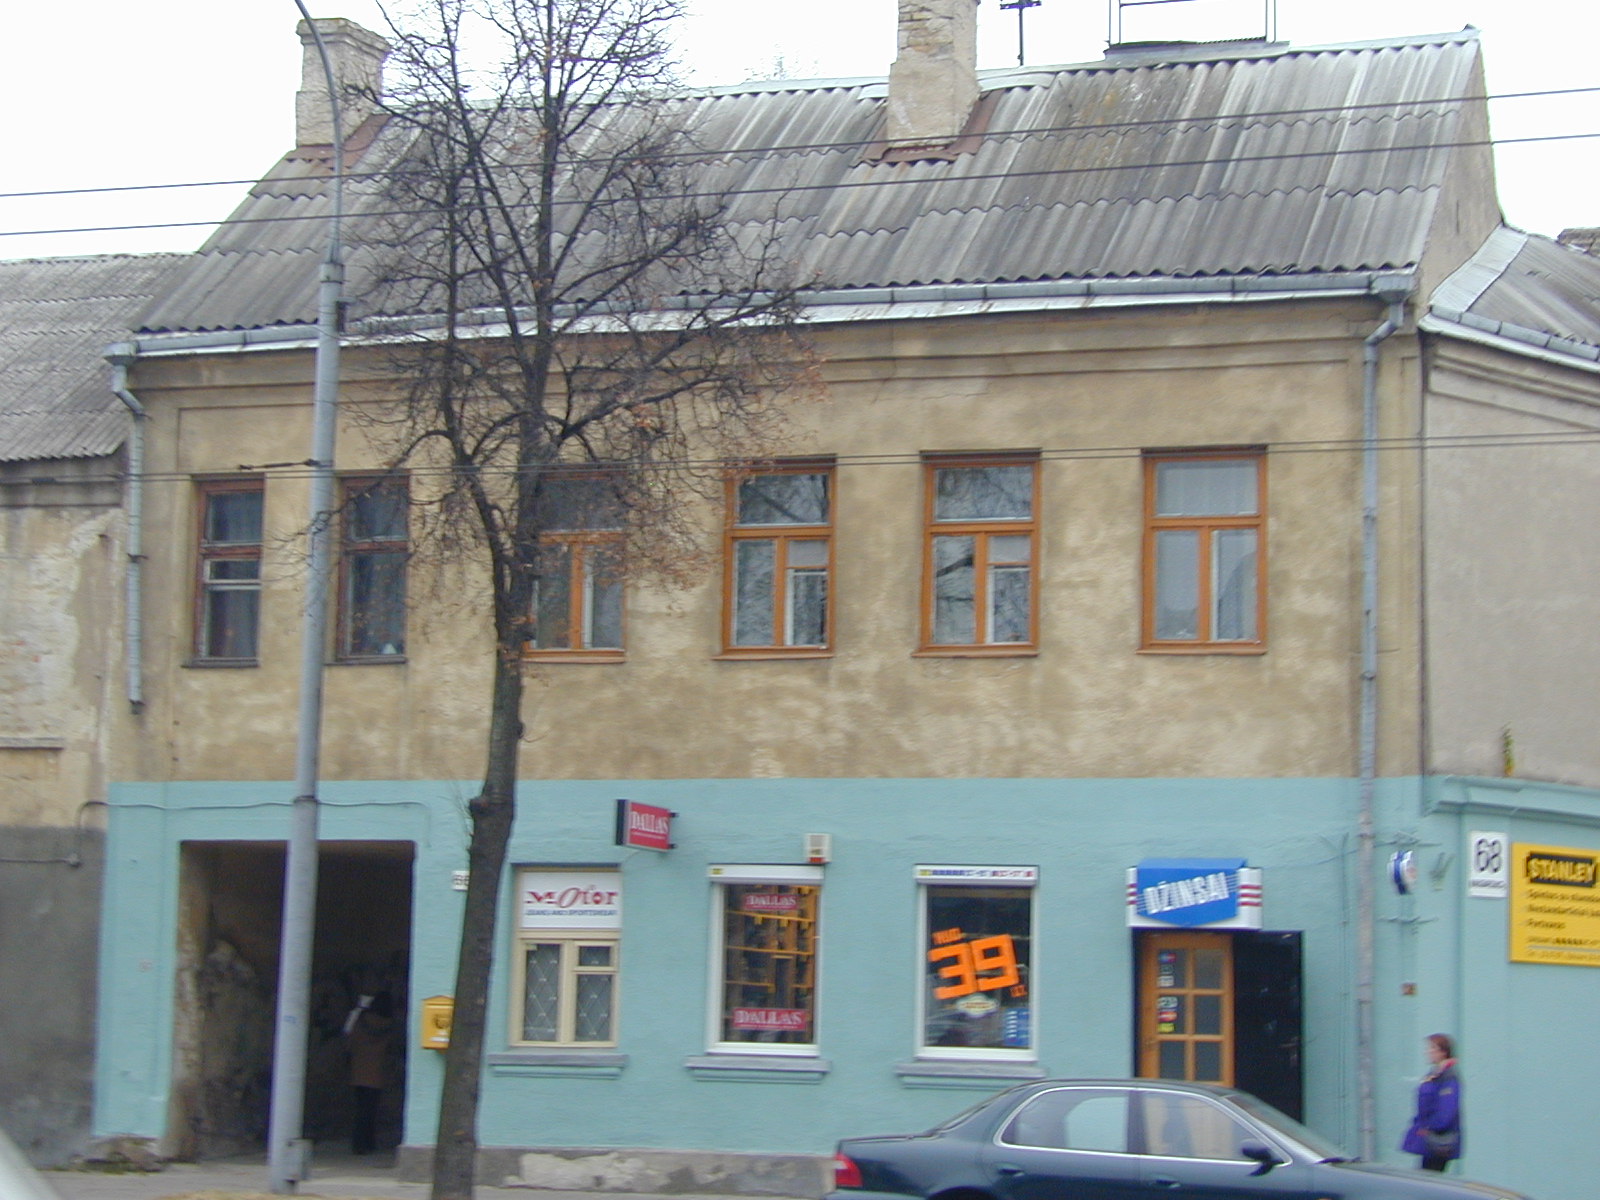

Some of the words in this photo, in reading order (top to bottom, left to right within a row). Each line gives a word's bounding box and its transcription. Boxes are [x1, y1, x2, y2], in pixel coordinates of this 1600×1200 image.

[630, 811, 669, 834] DALLAS
[1474, 838, 1502, 873] 68
[1528, 858, 1595, 883] STANLEY
[747, 894, 797, 906] DALLAS
[1143, 871, 1229, 914] DŽINSAI
[927, 933, 1020, 1000] 39
[735, 1010, 802, 1025] DALLAS
